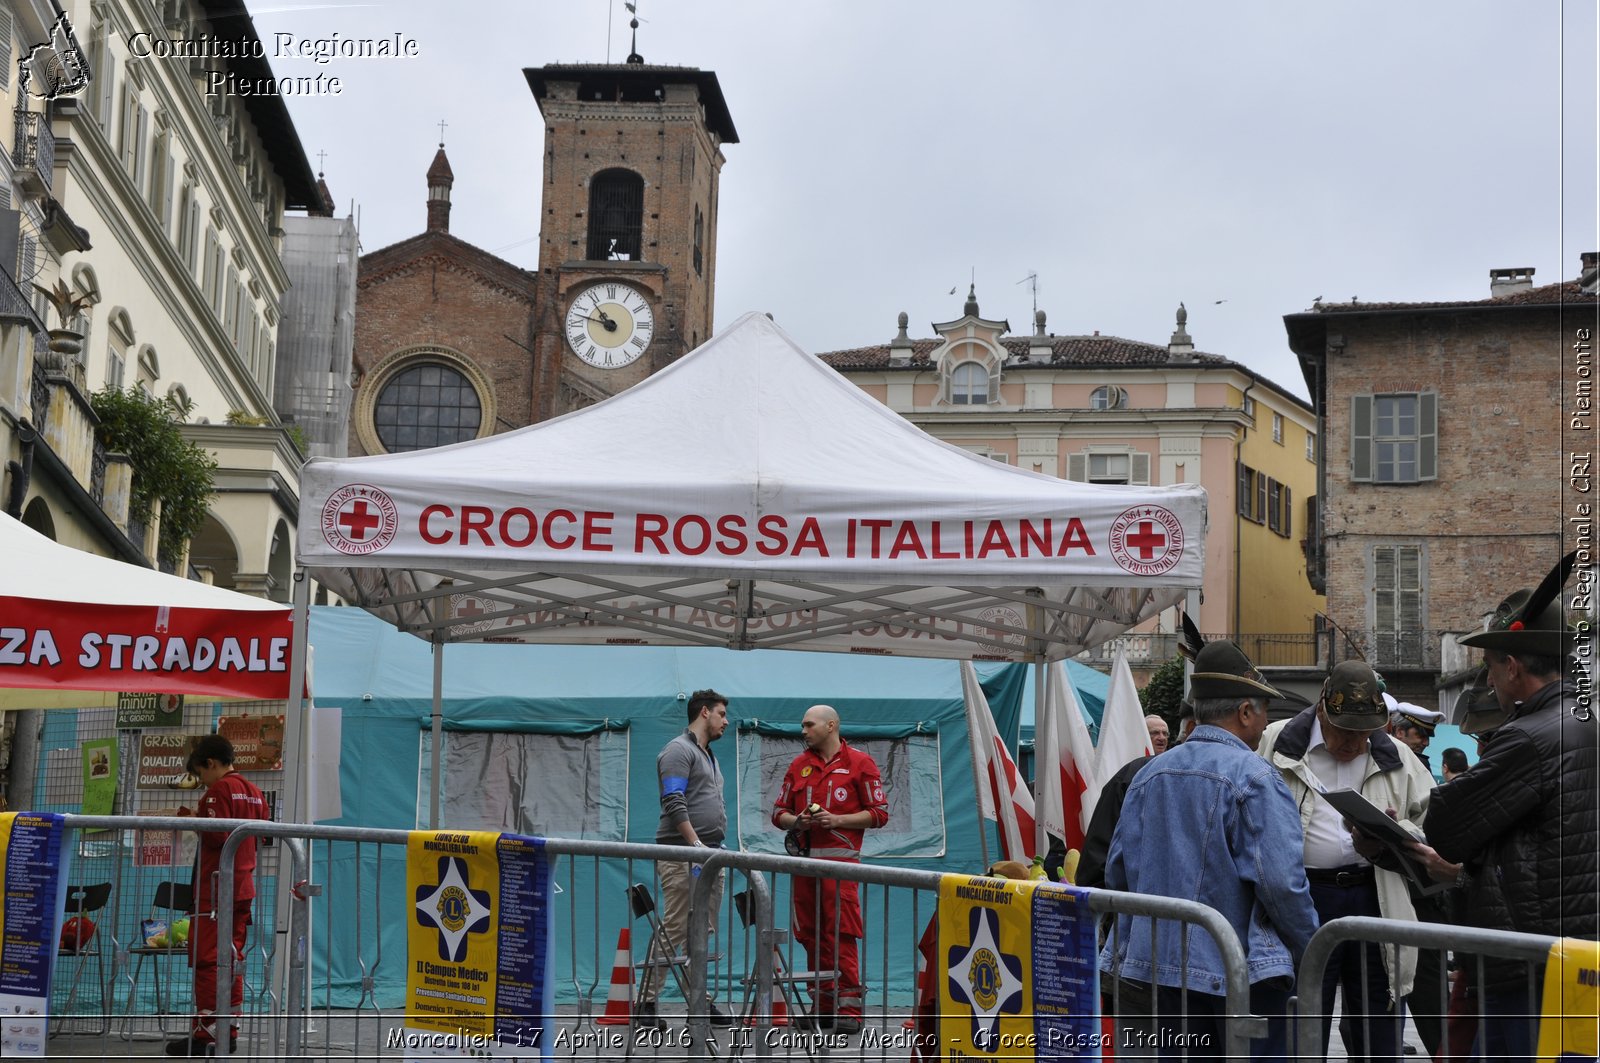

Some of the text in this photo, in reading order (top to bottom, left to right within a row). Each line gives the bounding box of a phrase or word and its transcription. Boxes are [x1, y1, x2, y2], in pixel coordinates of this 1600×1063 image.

[324, 488, 356, 542] 22 AGOSTO 1864
[370, 490, 395, 542] CONVENZIONE
[418, 504, 1096, 560] CROCE ROSSA ITALIANA
[1112, 509, 1141, 565] 22 AGOSTO 1864
[1155, 510, 1181, 559] CONVENZIONE
[336, 538, 372, 553] GINEVRA
[1128, 560, 1164, 574] GINEVRA
[78, 632, 289, 672] STRADALE
[143, 831, 172, 840] EVANDE
[435, 833, 470, 844] LIONS CLUB
[424, 841, 479, 855] MONCALIERI HOST
[968, 878, 1007, 890] LIONS CLUB
[444, 888, 464, 899] LIONS
[956, 886, 1013, 904] MONCALIERI HOST
[450, 900, 458, 922] L
[974, 952, 996, 966] LIONS
[417, 961, 488, 982] II Campus Medico
[981, 968, 990, 990] L
[416, 988, 486, 1005] Prevenzione Sanitaria Gratuita
[415, 1002, 445, 1013] Domenica
